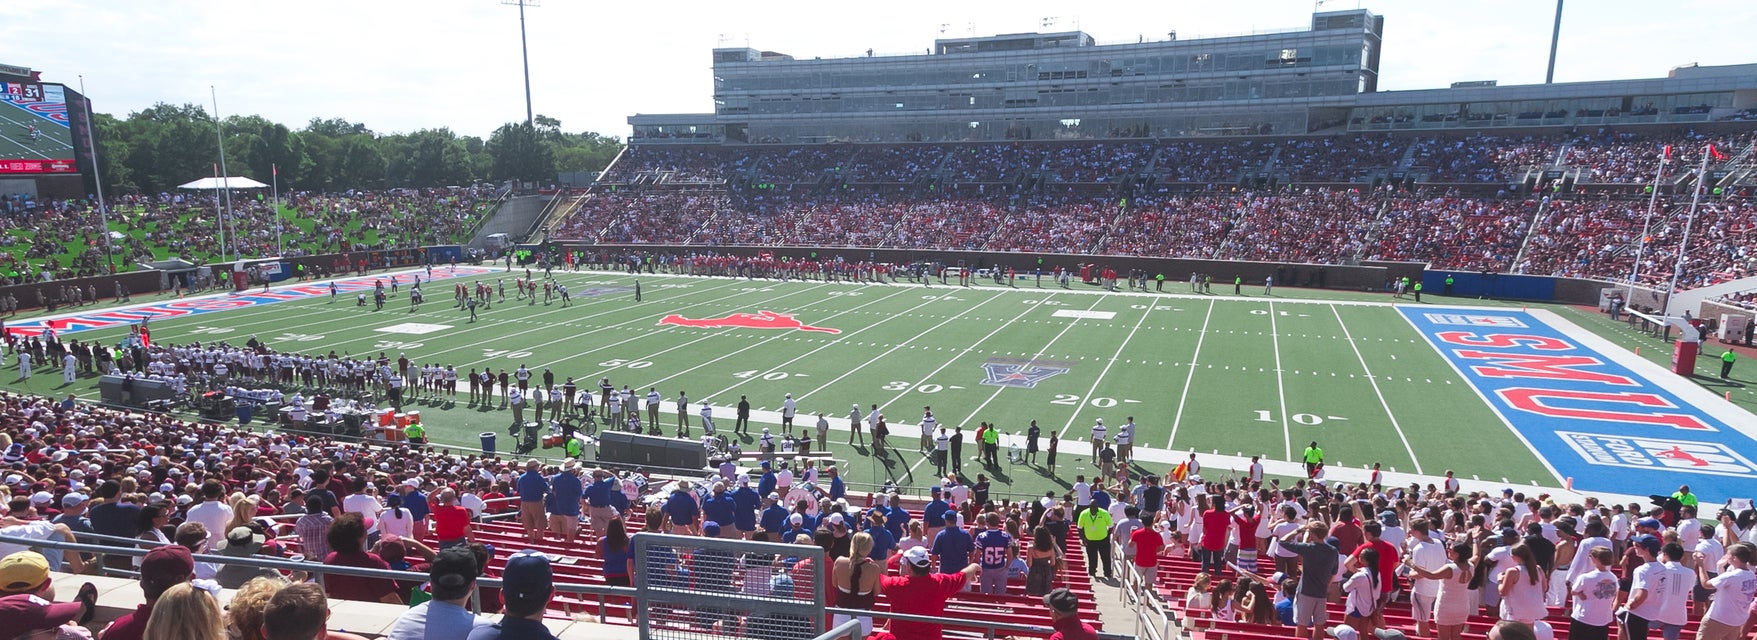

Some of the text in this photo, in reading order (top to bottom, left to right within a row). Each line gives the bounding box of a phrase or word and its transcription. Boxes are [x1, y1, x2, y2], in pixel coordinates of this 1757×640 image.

[25, 88, 40, 98] 31
[598, 358, 653, 368] 50
[732, 369, 789, 381] 40
[1434, 330, 1720, 432] SMU
[881, 380, 944, 394] 30
[1049, 394, 1118, 408] 20
[1253, 409, 1323, 426] 10
[1597, 437, 1653, 466] FORD
[984, 546, 1005, 565] 65
